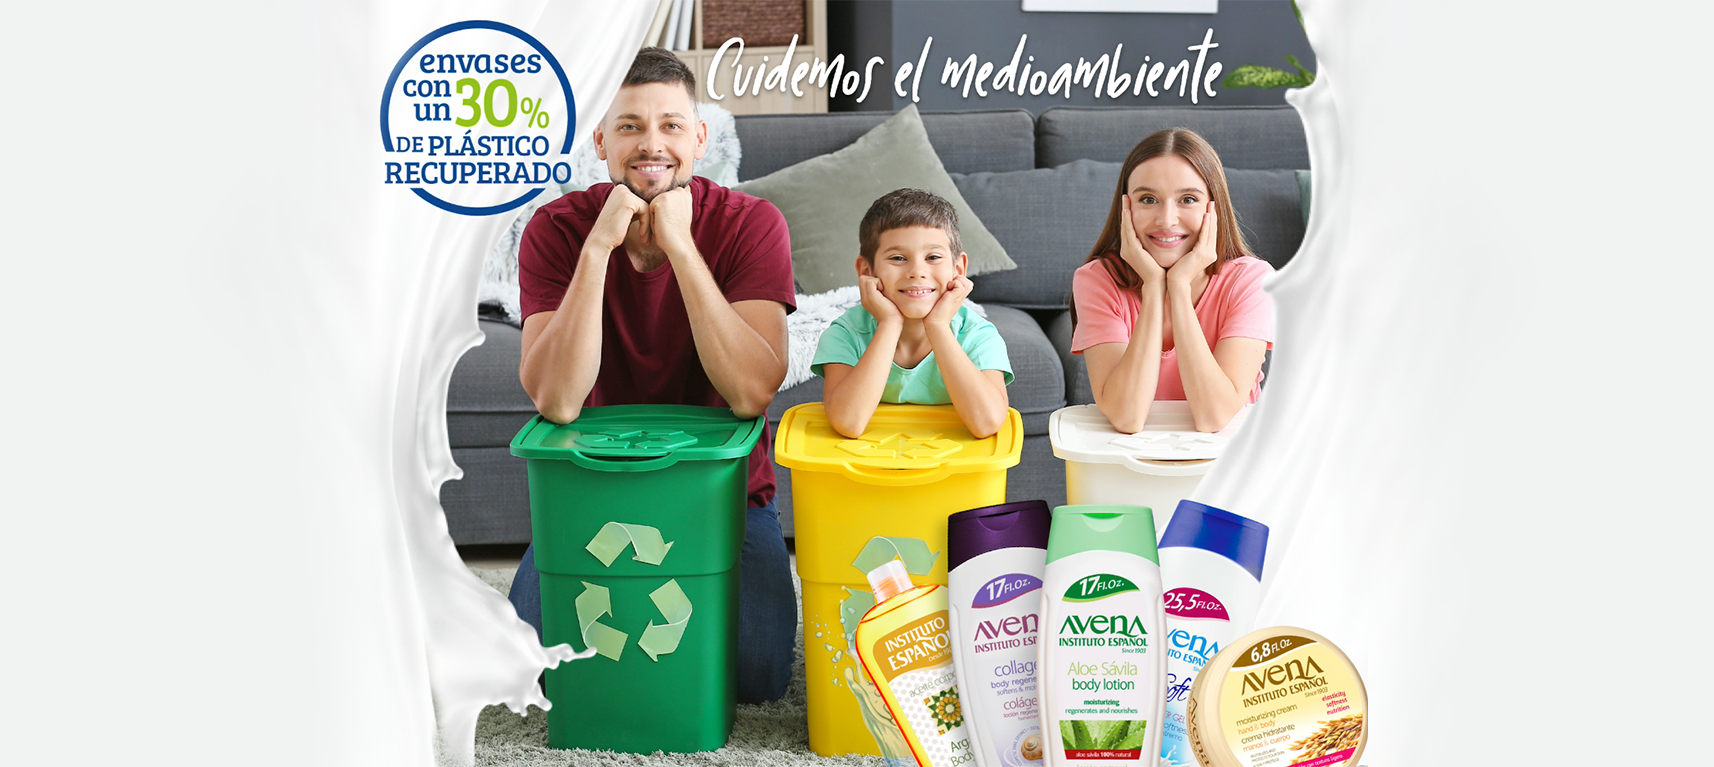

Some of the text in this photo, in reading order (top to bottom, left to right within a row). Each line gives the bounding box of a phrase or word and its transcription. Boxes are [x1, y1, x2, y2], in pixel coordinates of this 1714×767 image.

[884, 617, 945, 653] INSTITUTO
[1059, 637, 1106, 647] INSTITUTO
[974, 638, 1021, 654] INSTITUTO
[1250, 641, 1271, 663] 6,8
[1067, 660, 1138, 676] Aloe Sávila
[909, 681, 934, 698] aceite
[990, 680, 1010, 689] body
[1072, 678, 1135, 693] body lotion
[1243, 687, 1288, 708] INSTITUTO
[1304, 687, 1328, 698] Since 1903
[1322, 691, 1346, 702] elasticity
[1083, 699, 1120, 707] moisturizing
[1326, 697, 1348, 708] softness
[1326, 705, 1351, 715] nutrition
[1236, 703, 1298, 727] moisturizing cream
[1237, 720, 1276, 735] hand & body
[1241, 723, 1296, 745] crema hidratante
[1243, 741, 1264, 753] manos
[1269, 734, 1291, 746] cuerpo
